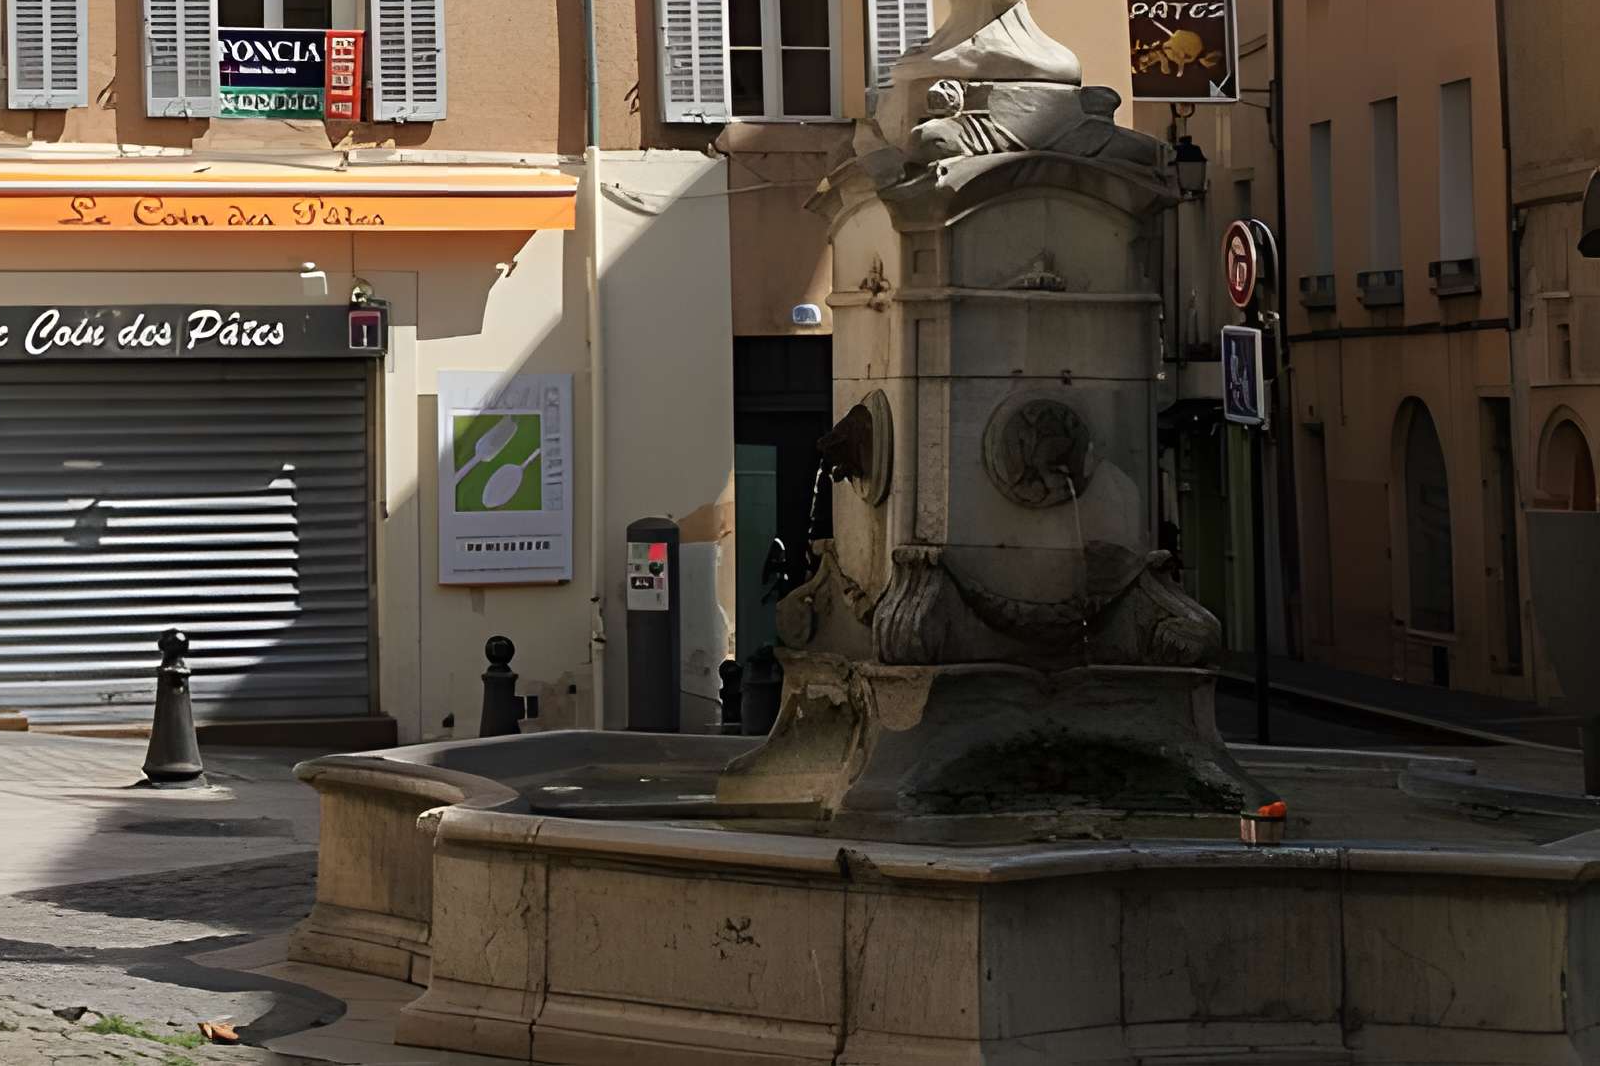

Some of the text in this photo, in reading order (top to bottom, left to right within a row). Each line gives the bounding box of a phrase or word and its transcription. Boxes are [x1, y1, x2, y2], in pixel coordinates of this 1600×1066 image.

[58, 197, 111, 226] Le
[133, 197, 213, 227] Coin
[24, 309, 105, 355] Coin
[117, 313, 172, 348] des
